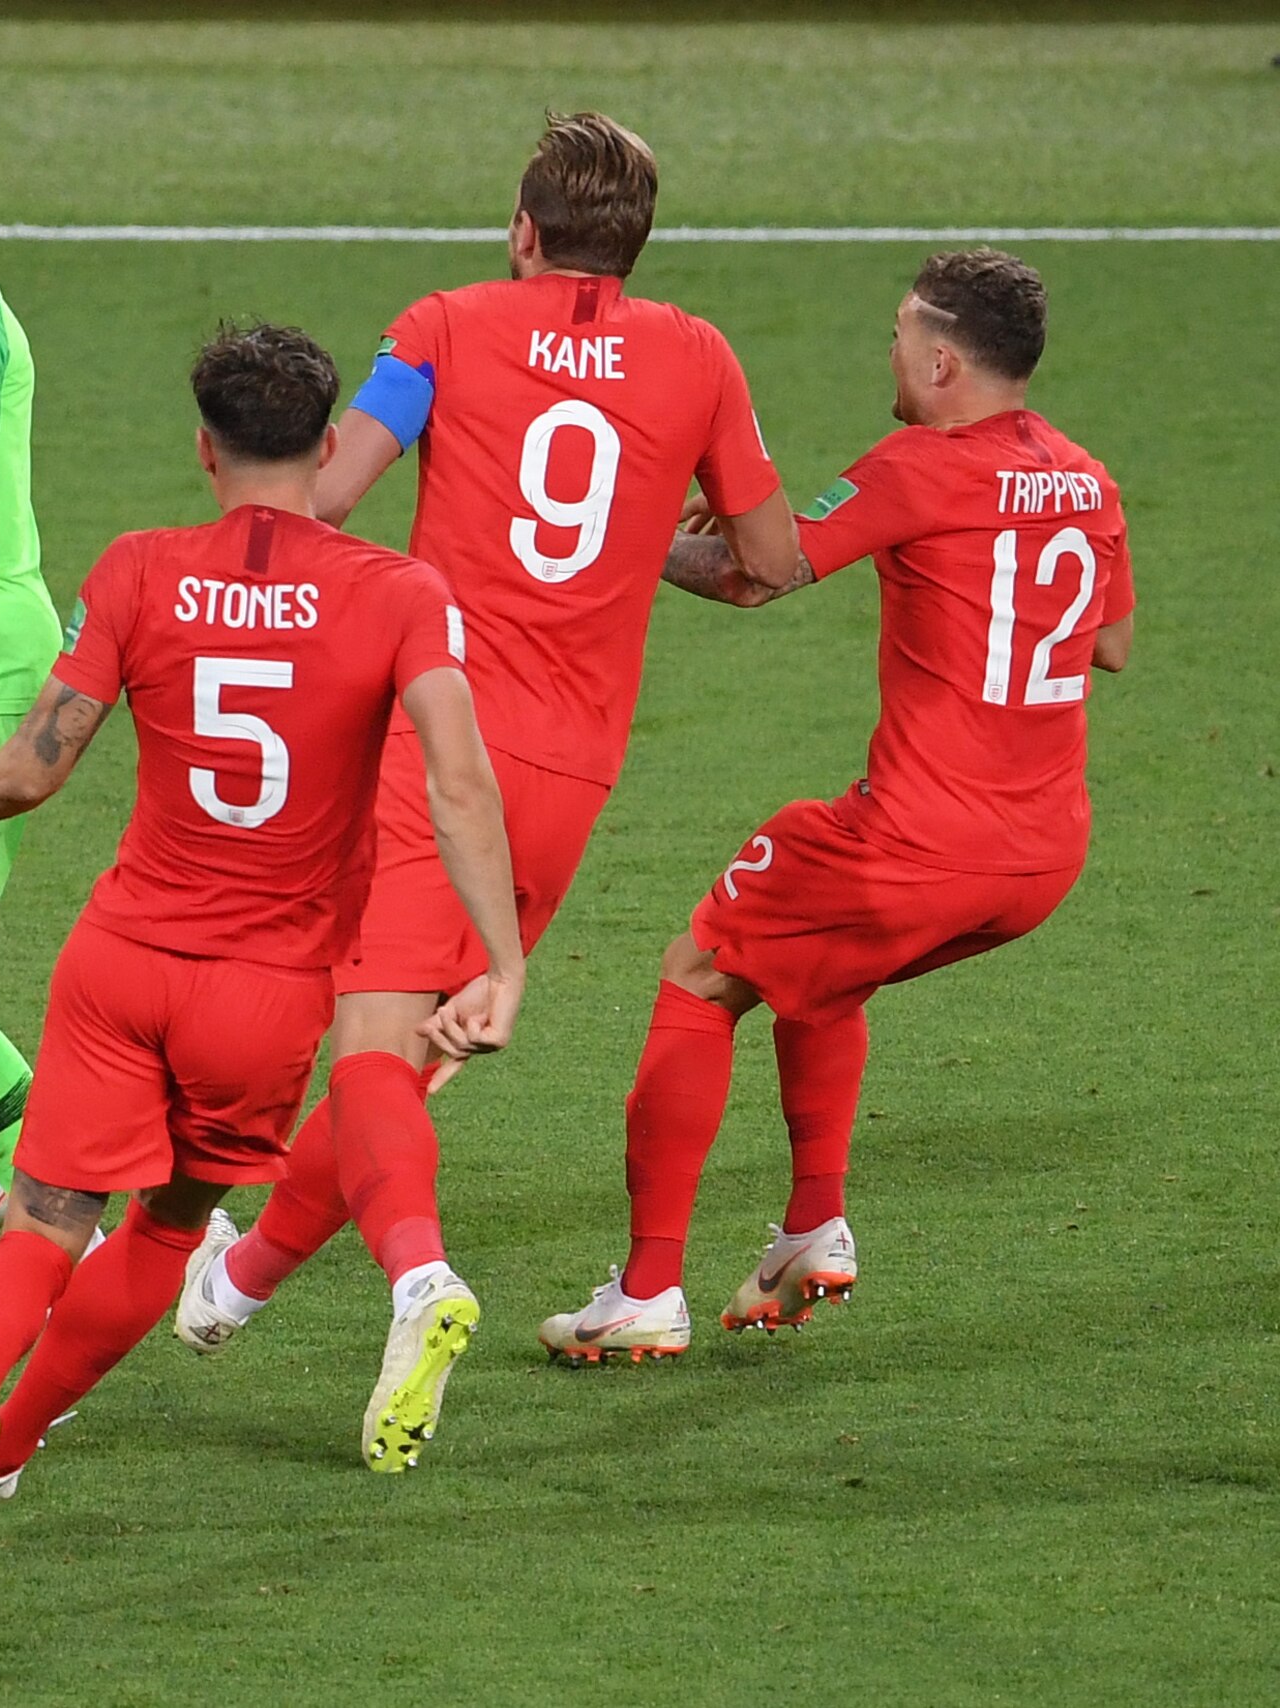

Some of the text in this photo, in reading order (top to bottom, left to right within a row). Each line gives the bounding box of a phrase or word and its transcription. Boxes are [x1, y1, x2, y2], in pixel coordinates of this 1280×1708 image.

[528, 329, 626, 380] KANE
[509, 400, 621, 584] 9
[996, 470, 1102, 514] TRIPPIER
[174, 575, 319, 629] STONES
[982, 526, 1096, 706] 12
[189, 656, 293, 829] 5
[724, 835, 773, 900] 2
